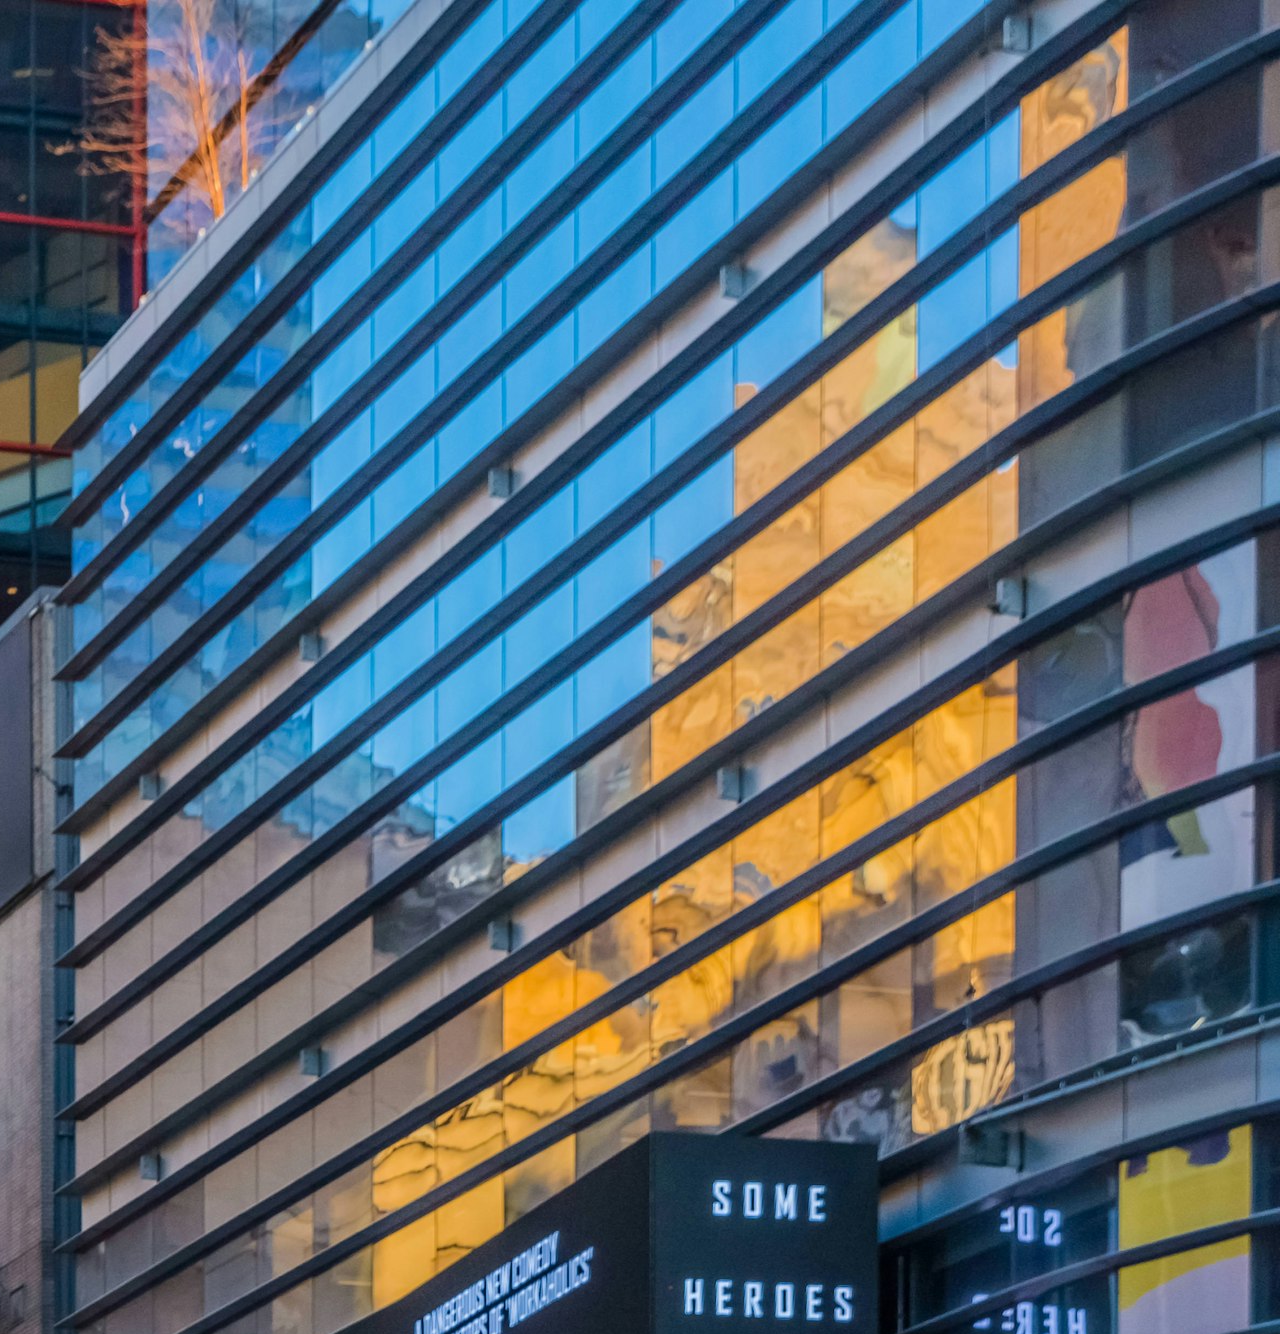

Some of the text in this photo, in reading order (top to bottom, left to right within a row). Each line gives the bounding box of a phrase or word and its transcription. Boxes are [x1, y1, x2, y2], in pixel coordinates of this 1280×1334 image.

[712, 1179, 827, 1222] SOME
[485, 1258, 513, 1309] NEW
[511, 1230, 560, 1289] COMEDY
[684, 1278, 854, 1323] HEROES
